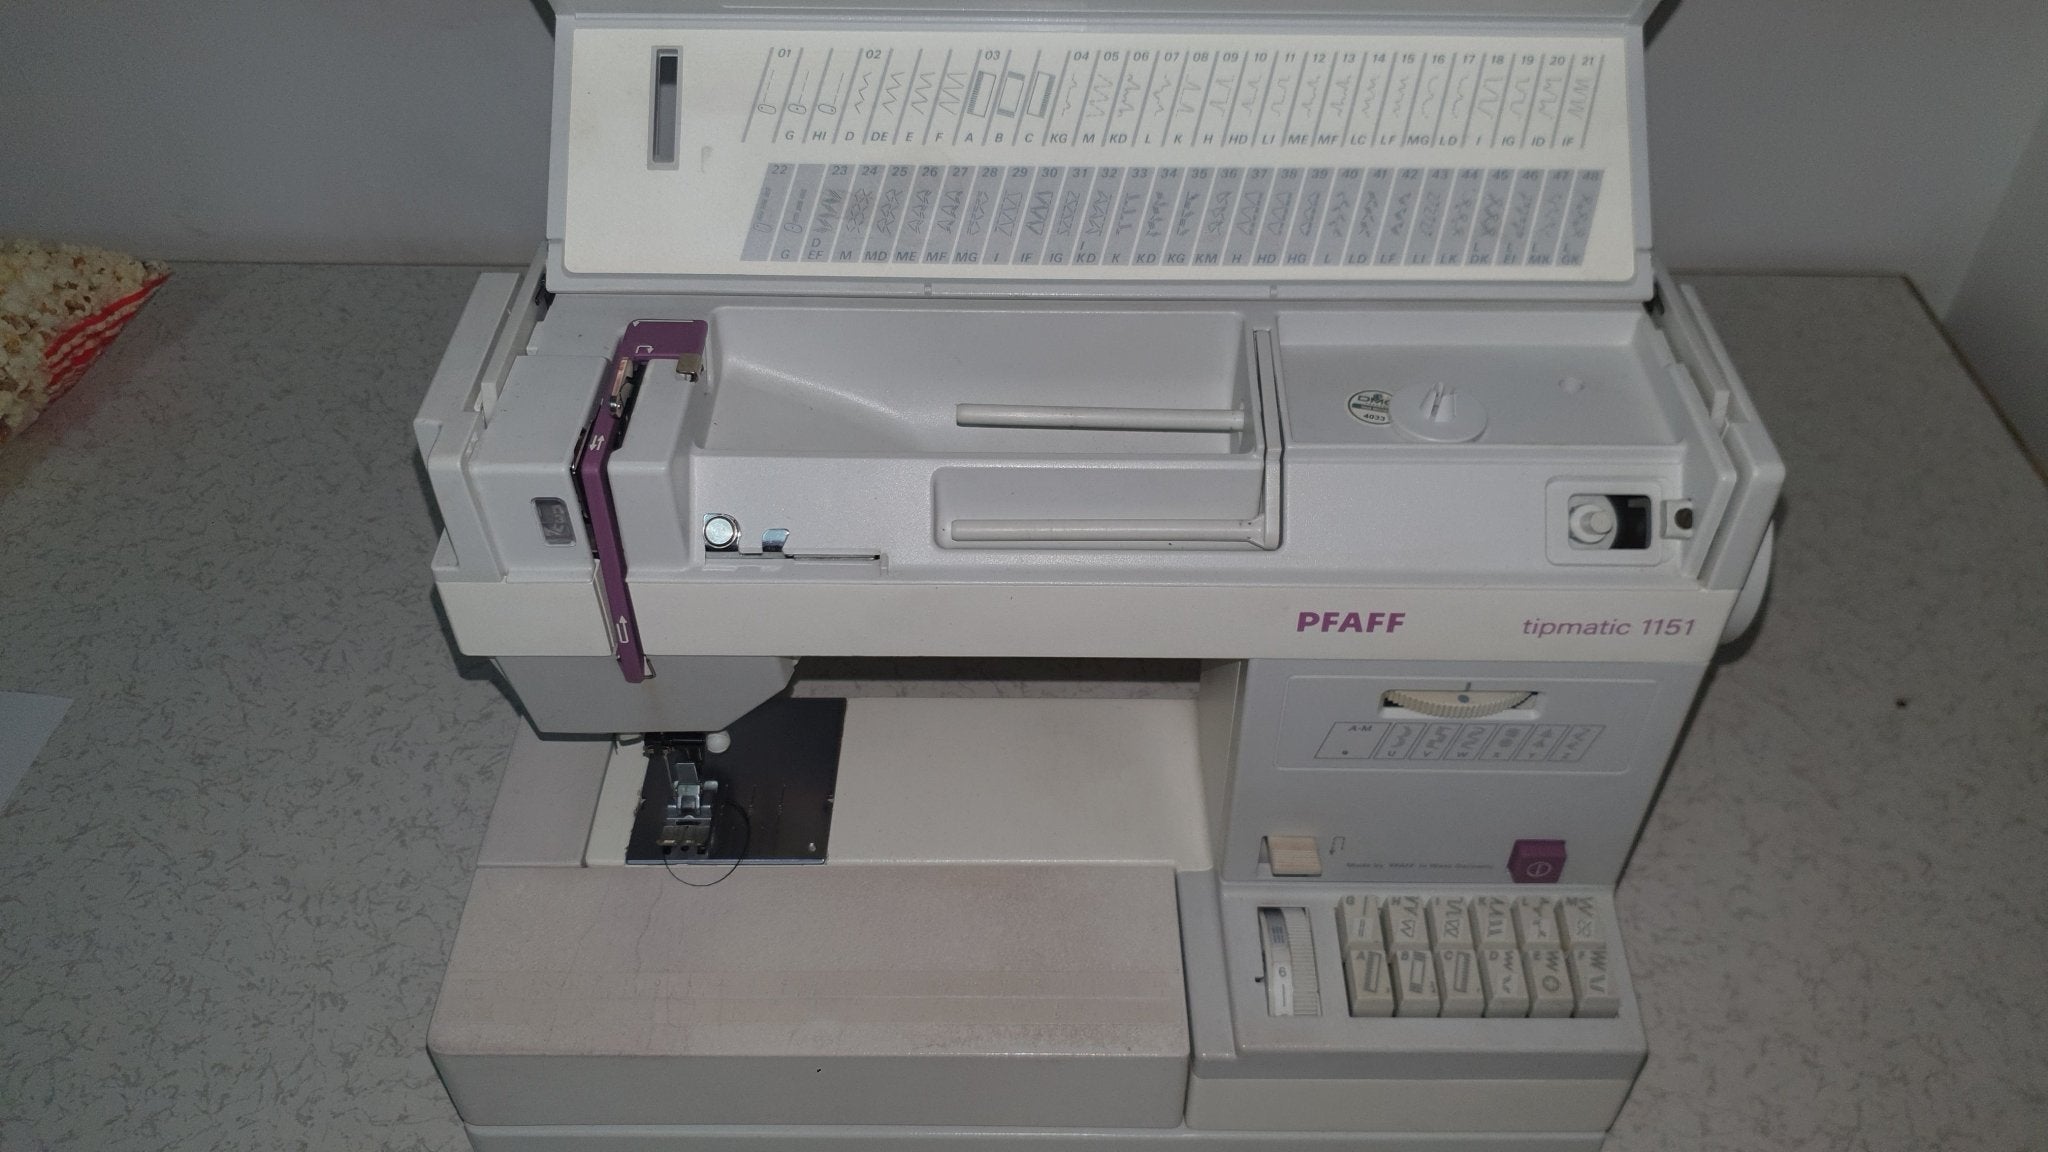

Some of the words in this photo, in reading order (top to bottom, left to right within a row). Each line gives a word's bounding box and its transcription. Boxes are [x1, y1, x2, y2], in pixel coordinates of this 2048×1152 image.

[778, 49, 791, 57] 01
[866, 50, 881, 59] 02
[985, 50, 1001, 60] 03
[1074, 51, 1090, 61] 04
[1104, 51, 1119, 61] 05
[1134, 52, 1150, 61] 06
[1164, 52, 1180, 62] 07
[1193, 52, 1209, 62] 08
[1223, 53, 1239, 62] 09
[1255, 53, 1268, 63] 10
[1285, 53, 1296, 63] 11
[1314, 53, 1326, 63] 12
[1344, 54, 1356, 63] 13
[1373, 54, 1386, 64] 14
[1403, 54, 1415, 64] 15
[1433, 54, 1446, 64] 16
[1464, 55, 1475, 64] 17
[1492, 55, 1505, 65] 18
[1522, 55, 1534, 65] 19
[1550, 56, 1565, 65] 20
[1582, 56, 1594, 66] 21
[786, 131, 795, 140] G
[812, 131, 827, 140] HI
[845, 132, 855, 141] D
[871, 132, 888, 141] DE
[906, 132, 914, 142] E
[935, 132, 944, 142] F
[964, 133, 973, 142] A
[995, 133, 1004, 143] B
[1025, 133, 1034, 143] C
[1050, 134, 1067, 143] KG
[1083, 134, 1095, 143] M
[1110, 134, 1128, 144] KD
[1145, 134, 1151, 144] L
[1174, 134, 1183, 144] K
[1203, 134, 1213, 144] H
[1229, 135, 1248, 144] HD
[1262, 135, 1276, 145] LI
[1288, 135, 1309, 145] ME
[1318, 135, 1339, 145] MF
[1351, 136, 1367, 145] LC
[1380, 136, 1396, 145] LF
[1407, 136, 1430, 145] MG
[1440, 136, 1457, 146] LD
[1502, 136, 1515, 146] IG
[1531, 136, 1546, 146] ID
[1562, 137, 1574, 146] IF
[772, 165, 787, 174] 22
[832, 166, 848, 175] 23
[862, 166, 878, 176] 24
[892, 167, 908, 176] 25
[922, 167, 938, 177] 26
[953, 167, 968, 177] 27
[982, 168, 998, 177] 28
[1012, 168, 1028, 177] 29
[1042, 168, 1058, 178] 30
[1073, 168, 1087, 178] 31
[1101, 168, 1118, 178] 32
[1132, 168, 1148, 178] 33
[1161, 168, 1178, 178] 34
[1192, 169, 1208, 179] 35
[1221, 169, 1238, 179] 36
[1251, 169, 1267, 179] 37
[1281, 169, 1298, 179] 38
[1312, 169, 1328, 179] 39
[1342, 169, 1358, 179] 40
[1374, 169, 1387, 180] 41
[1401, 169, 1418, 180] 42
[1432, 170, 1448, 180] 43
[1461, 170, 1478, 180] 44
[1492, 170, 1509, 180] 45
[1522, 170, 1538, 181] 46
[1553, 171, 1570, 181] 47
[1583, 171, 1599, 181] 48
[781, 249, 790, 259] G
[808, 251, 824, 260] EF
[840, 251, 852, 260] M
[865, 251, 887, 261] MD
[896, 252, 919, 261] ME
[926, 252, 948, 261] MF
[955, 252, 978, 262] MG
[1021, 253, 1034, 262] IF
[1050, 253, 1063, 263] IG
[1077, 253, 1096, 263] KD
[1112, 254, 1121, 263] K
[1137, 254, 1156, 263] KD
[1168, 254, 1185, 263] KG
[1196, 254, 1218, 263] KM
[1232, 254, 1242, 263] H
[1257, 254, 1276, 264] HD
[1324, 254, 1330, 264] L
[1349, 254, 1367, 264] LD
[1380, 254, 1396, 264] LF
[1297, 612, 1406, 633] PFAFF
[1523, 618, 1631, 638] tipmatic
[1642, 619, 1696, 636] 1151
